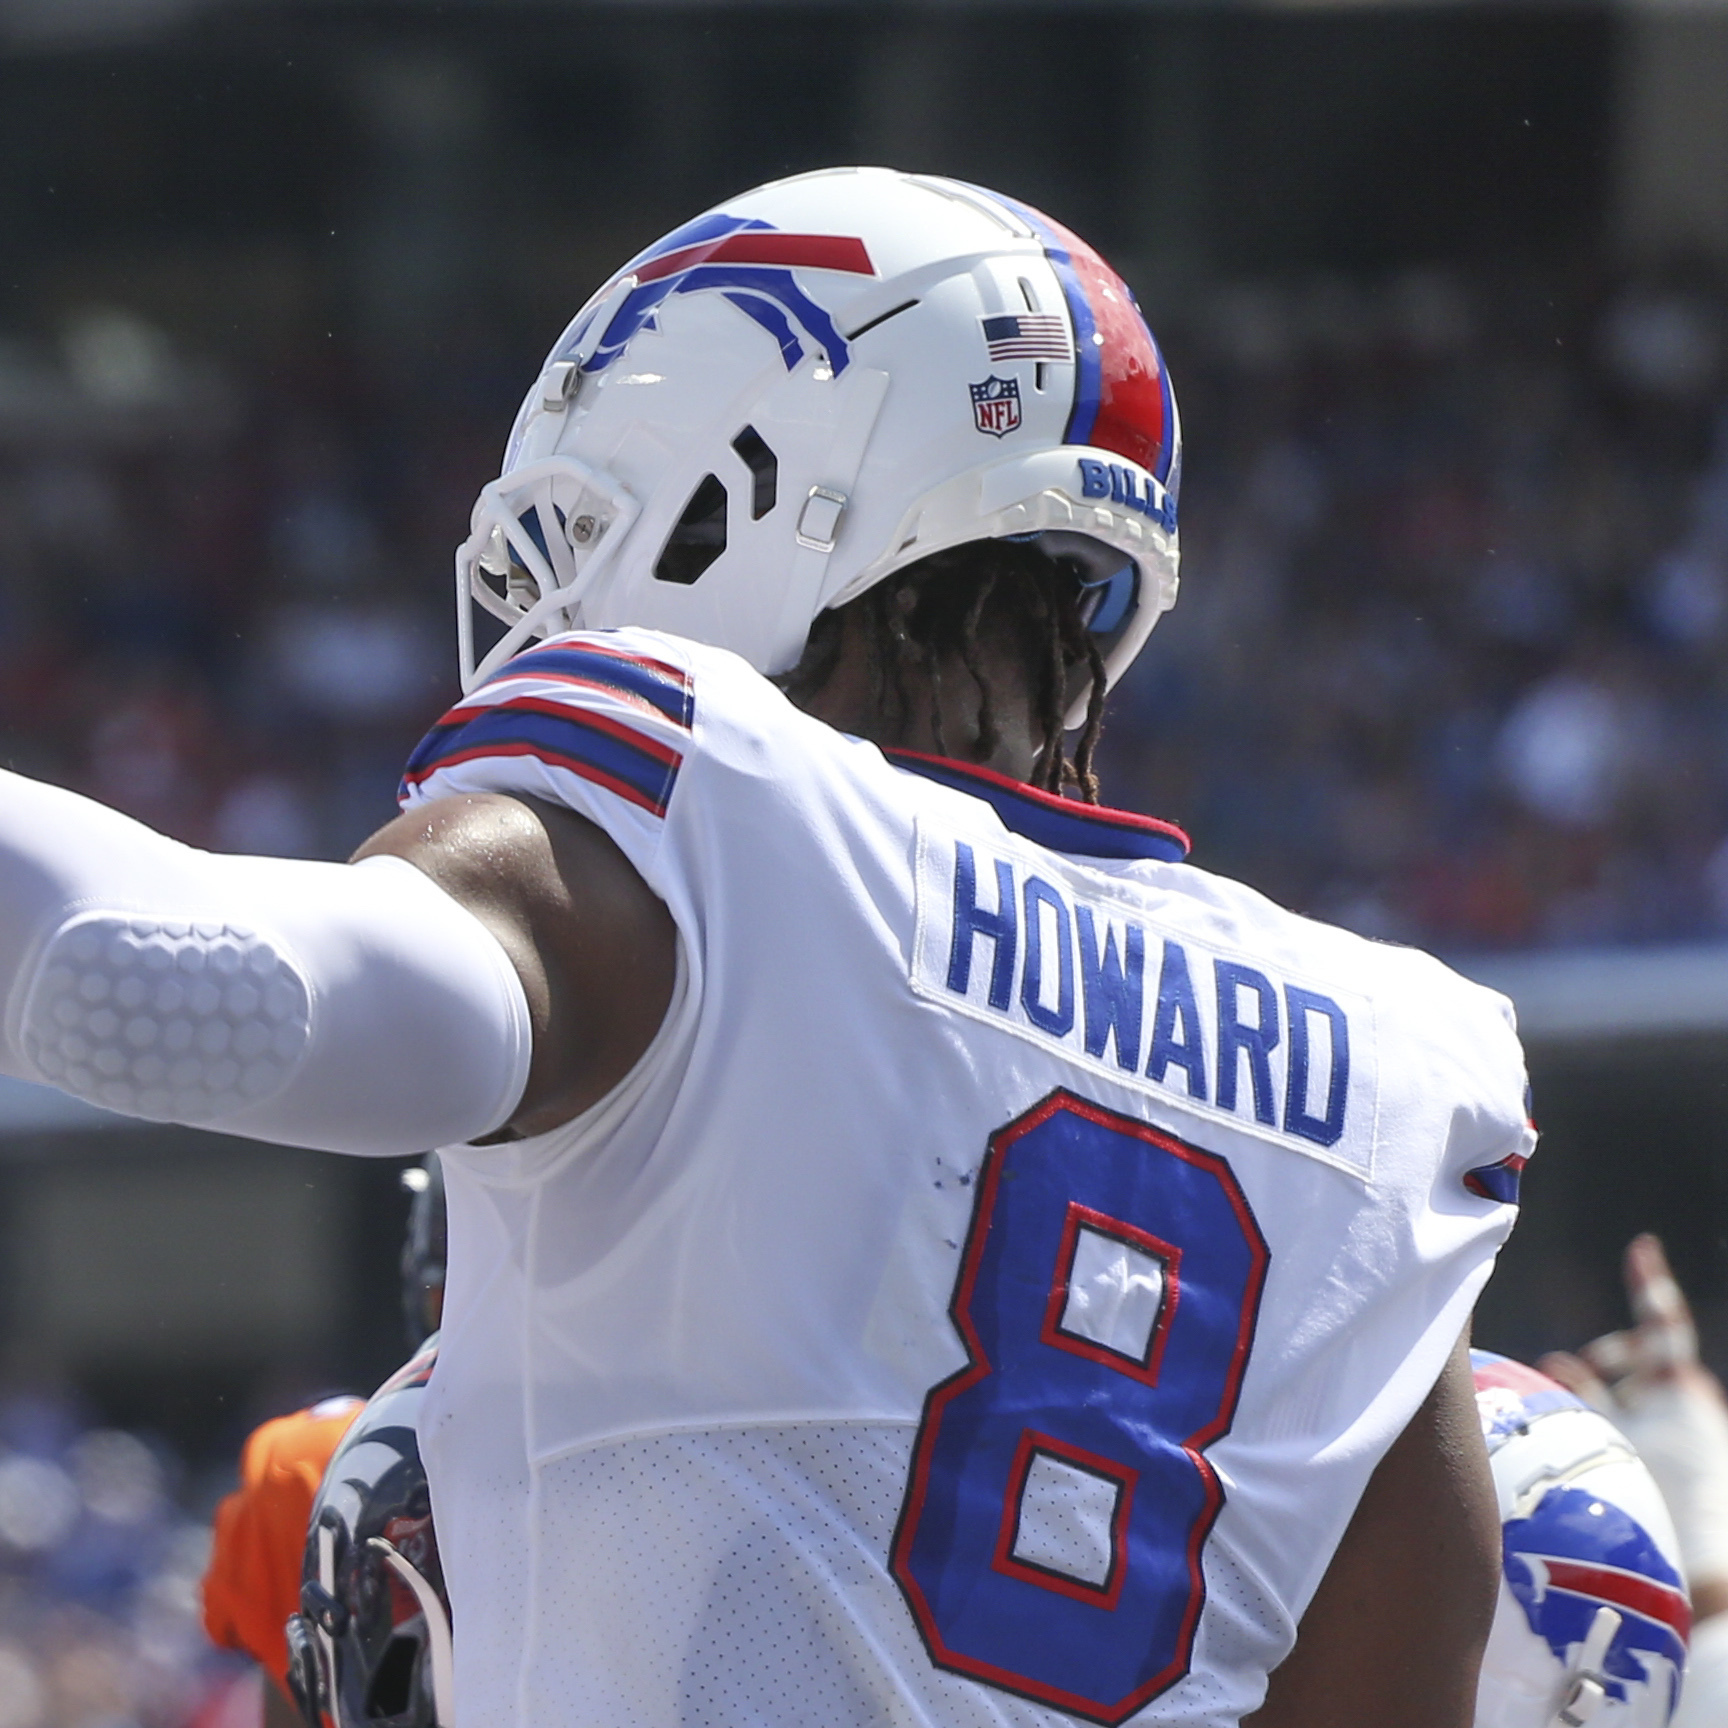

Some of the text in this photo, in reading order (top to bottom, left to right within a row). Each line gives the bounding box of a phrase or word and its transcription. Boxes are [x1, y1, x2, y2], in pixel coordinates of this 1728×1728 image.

[978, 400, 1018, 431] NFL
[1078, 458, 1177, 535] BILLS
[945, 840, 1350, 1149] HOWARD
[889, 1087, 1271, 1728] 8
